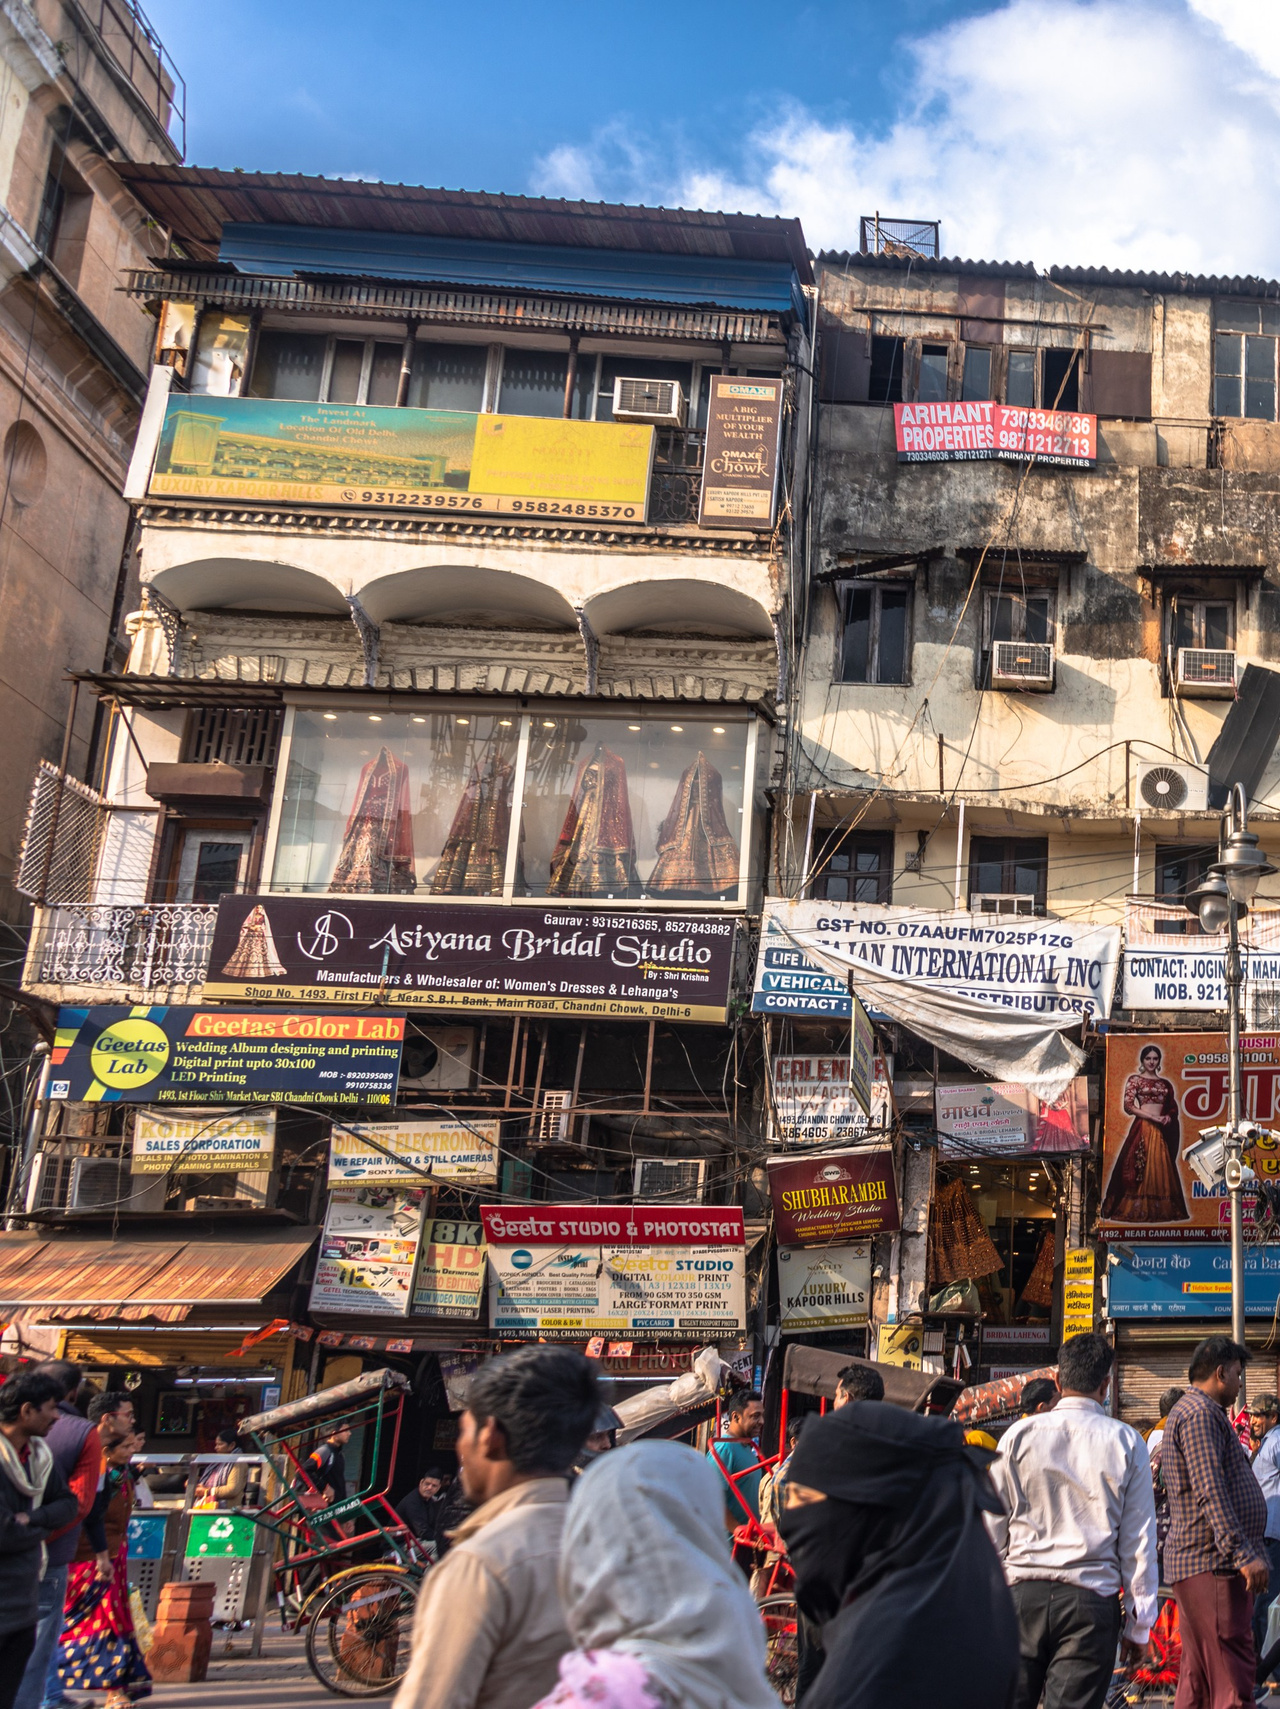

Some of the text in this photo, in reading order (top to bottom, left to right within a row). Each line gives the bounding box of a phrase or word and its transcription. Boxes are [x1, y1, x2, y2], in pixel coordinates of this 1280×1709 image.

[716, 413, 773, 424] MULTIPLIER
[901, 403, 993, 425] ARIHANT
[279, 423, 326, 432] Location
[323, 417, 377, 427] Landmark
[1001, 409, 1091, 435] 7303346036
[724, 431, 763, 440] WEALTH
[904, 424, 994, 450] PROPERTIES
[999, 431, 1090, 457] 9871212713
[722, 450, 763, 460] OMAXE
[906, 451, 949, 461] 7303346036
[998, 451, 1090, 467] ARIHANT PROPERTIES
[710, 457, 770, 477] Chowk
[151, 478, 323, 500] LUXURY HILLS
[361, 491, 636, 519] 9312239576 9582485370
[544, 914, 731, 936] Gaurav 9315216365, 8527843882
[816, 918, 1073, 948] GST NO. 07AAUFM7025P1ZG
[369, 923, 712, 967] Asiyana Bridal Studio
[772, 951, 799, 966] LIFE
[891, 945, 1102, 990] INTERNATIONAL INC
[1130, 958, 1187, 979] CONTACT:
[663, 971, 710, 983] Shri Krishna
[768, 974, 848, 994] VEHICAL,
[316, 970, 679, 1000] Manufacturers Wholesaler Women's Dresses Lehanga's
[1154, 983, 1192, 1000] MOB.
[245, 986, 691, 1018] Shop First Near Bank, Main Road, Chandni Chowk, Delhi-6
[765, 995, 839, 1010] CONTACT
[194, 1015, 400, 1039] Geetas Color Lab
[96, 1037, 167, 1052] Geetas
[175, 1041, 399, 1059] Wedding Album designing and printing
[107, 1059, 148, 1074] Lab
[173, 1057, 316, 1070] Digital print upto 30x100
[171, 1071, 247, 1085] LED Printing
[346, 1072, 394, 1080] 8920395089
[345, 1082, 393, 1090] 9910758336
[226, 1091, 358, 1103] Market Chandni Delhi
[145, 1139, 261, 1151] SALES CORPORATION
[394, 1130, 494, 1153] ELECTRONICS
[210, 1153, 260, 1161] LAMINATION
[350, 1154, 493, 1167] REPAIR CAMERAS
[213, 1162, 260, 1170] MATERIALS
[782, 1180, 888, 1211] SHUBHARAMBH
[791, 1205, 882, 1223] Wedding Studio
[433, 1222, 480, 1245] 8K
[559, 1221, 620, 1237] STUDIO
[643, 1222, 741, 1238] PHOTOSTAT
[1124, 1230, 1146, 1239] NEAR
[1148, 1230, 1181, 1239] CANARA
[1183, 1230, 1209, 1239] BANK,
[426, 1245, 482, 1269] HD
[675, 1260, 734, 1271] STUDIO
[1067, 1266, 1093, 1275] LAMINATIONS
[418, 1274, 444, 1289] VIDEO
[446, 1276, 481, 1291] EDITING
[612, 1273, 729, 1282] DIGITAL COLOUR PRINT
[803, 1282, 847, 1296] LUXURY
[612, 1301, 729, 1309] LARGE FORMAT PRINT
[787, 1292, 865, 1308] KAPOOR HILLS
[1013, 1331, 1047, 1339] LAHENGA
